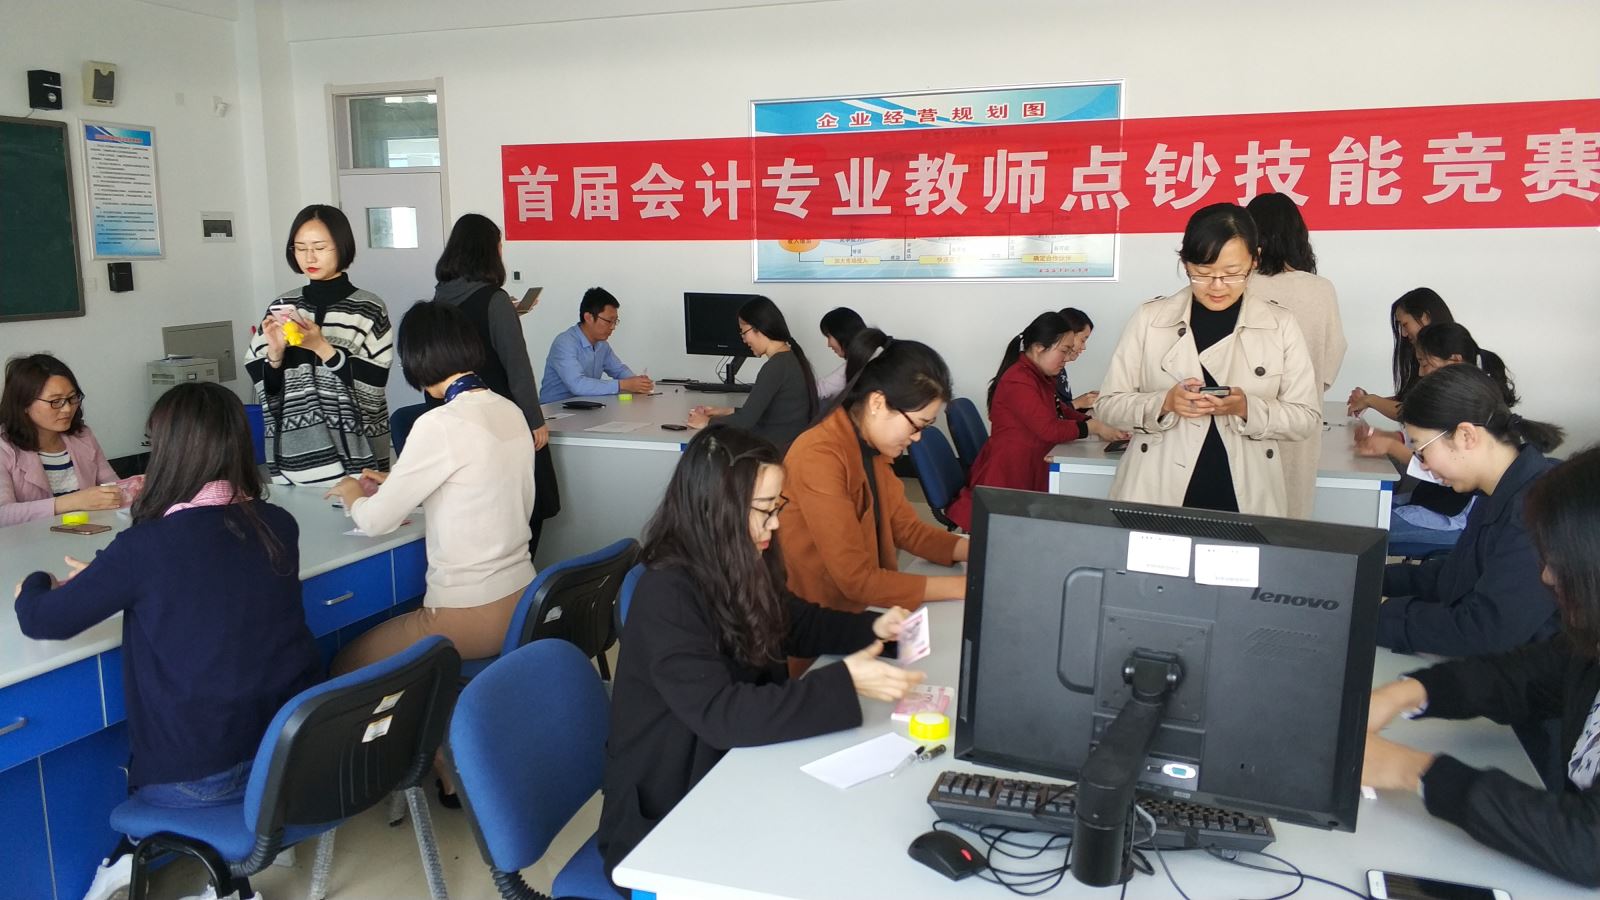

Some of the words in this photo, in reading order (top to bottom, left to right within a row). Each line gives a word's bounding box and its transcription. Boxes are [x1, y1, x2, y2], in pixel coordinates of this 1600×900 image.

[816, 102, 1046, 129] 企业经营规划图
[508, 128, 1600, 222] 首届会计专业教师点钞技能竞赛
[1250, 587, 1340, 611] lenovo
